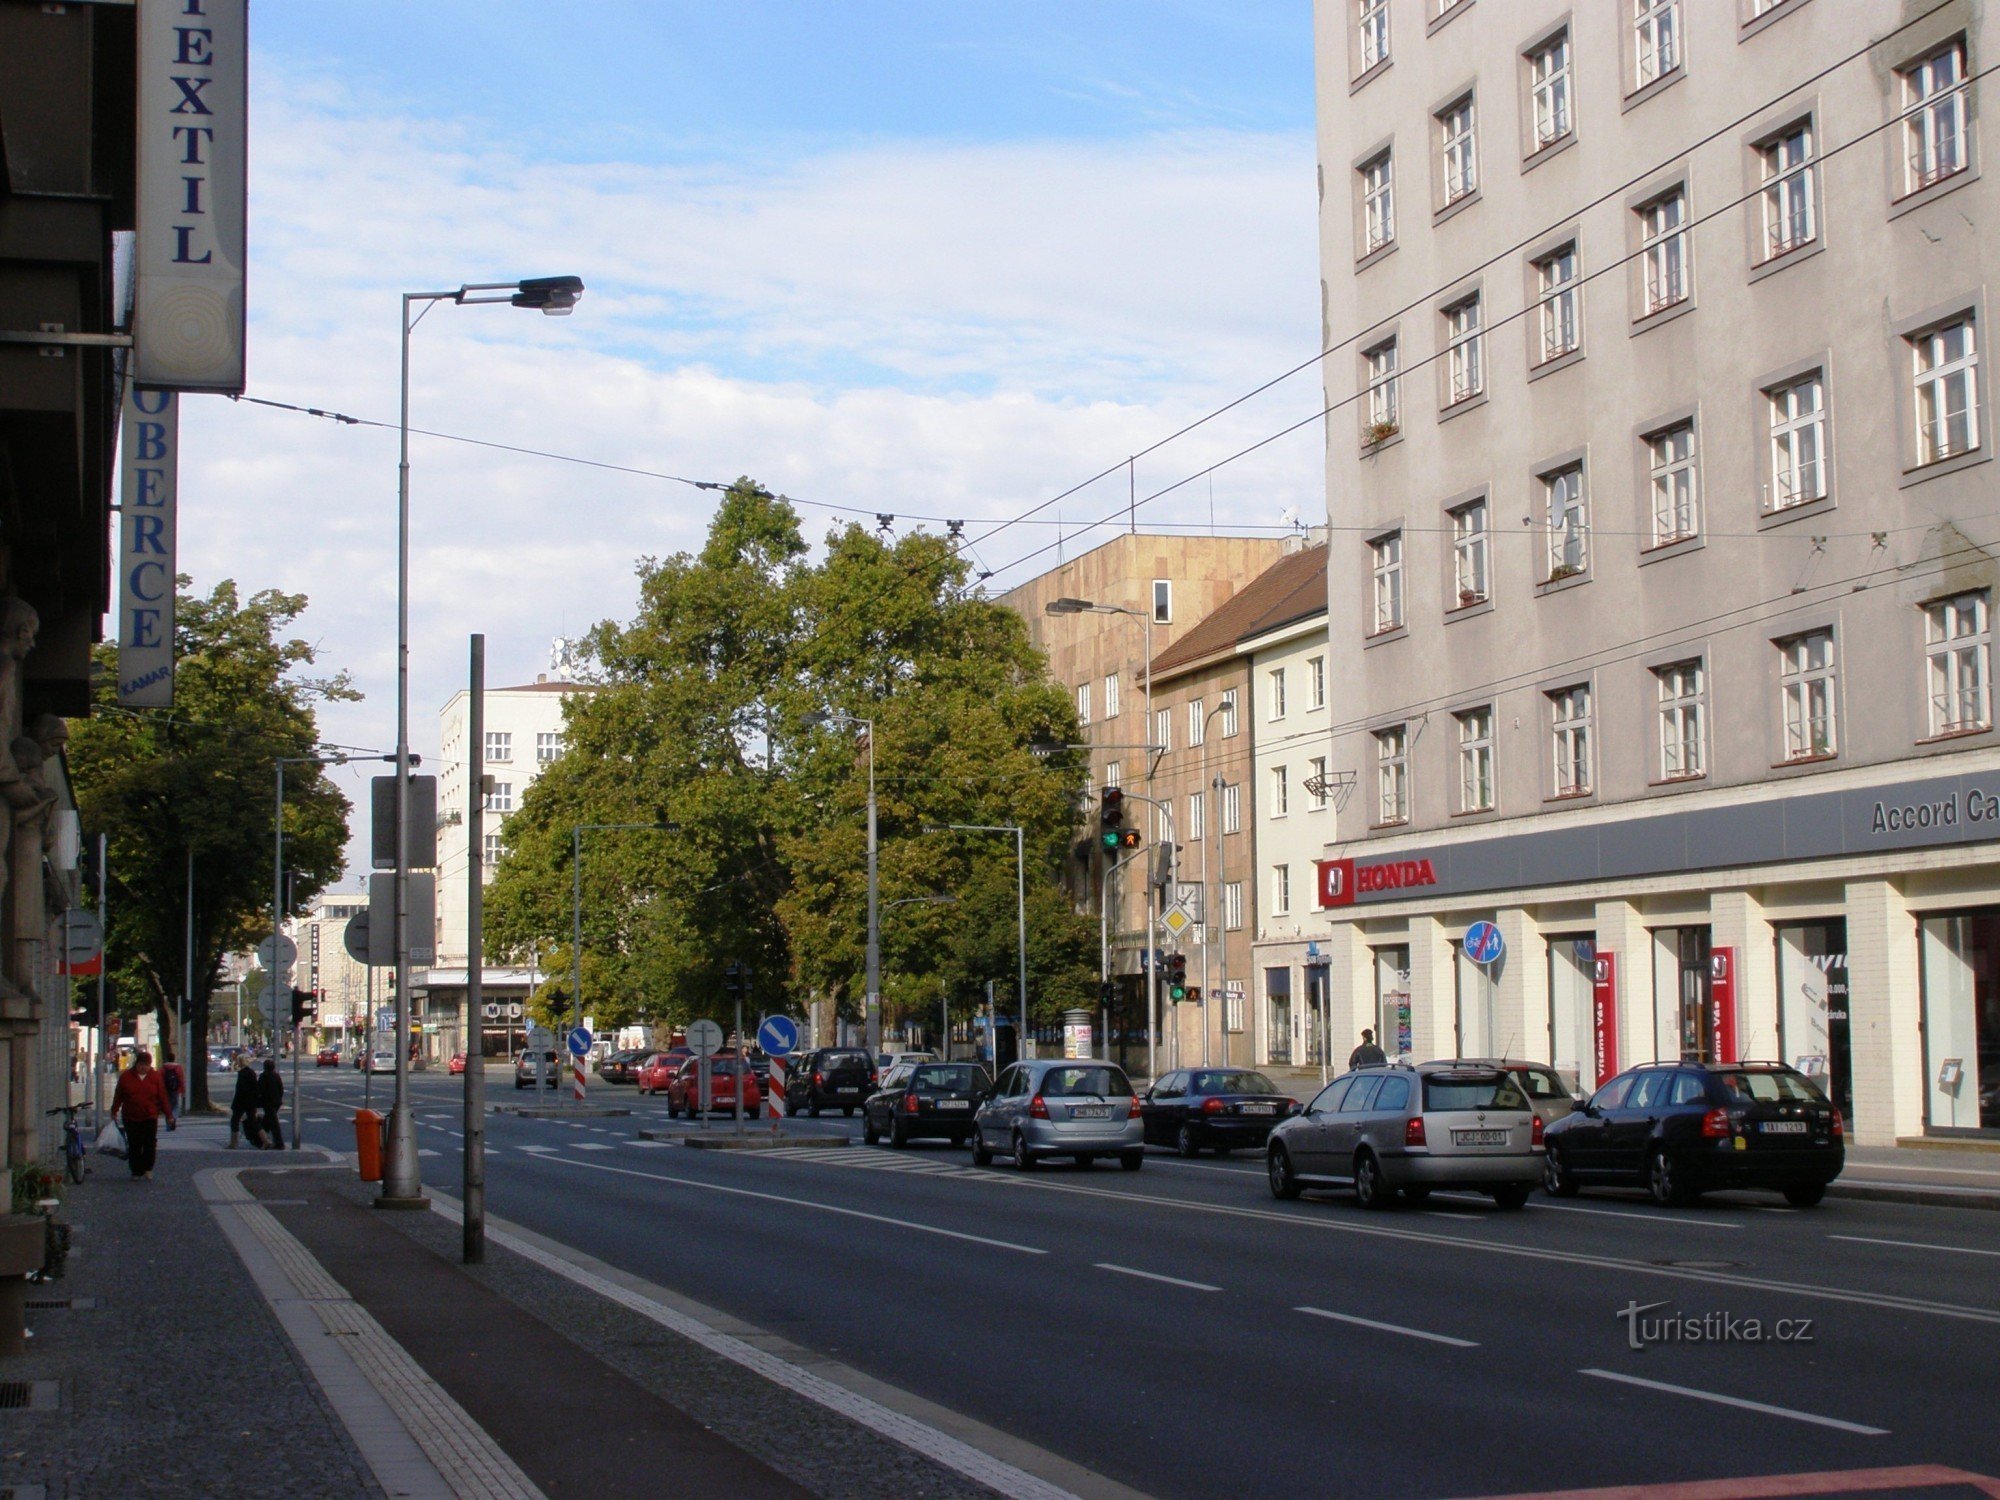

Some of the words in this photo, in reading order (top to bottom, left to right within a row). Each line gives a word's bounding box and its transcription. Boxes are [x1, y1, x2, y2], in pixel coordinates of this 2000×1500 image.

[120, 665, 171, 697] KAMAR
[1872, 791, 1958, 834] Accord
[1356, 858, 1437, 892] HONDA
[488, 1006, 498, 1016] M
[1460, 1132, 1475, 1142] JCJ
[1785, 1122, 1804, 1132] 1213
